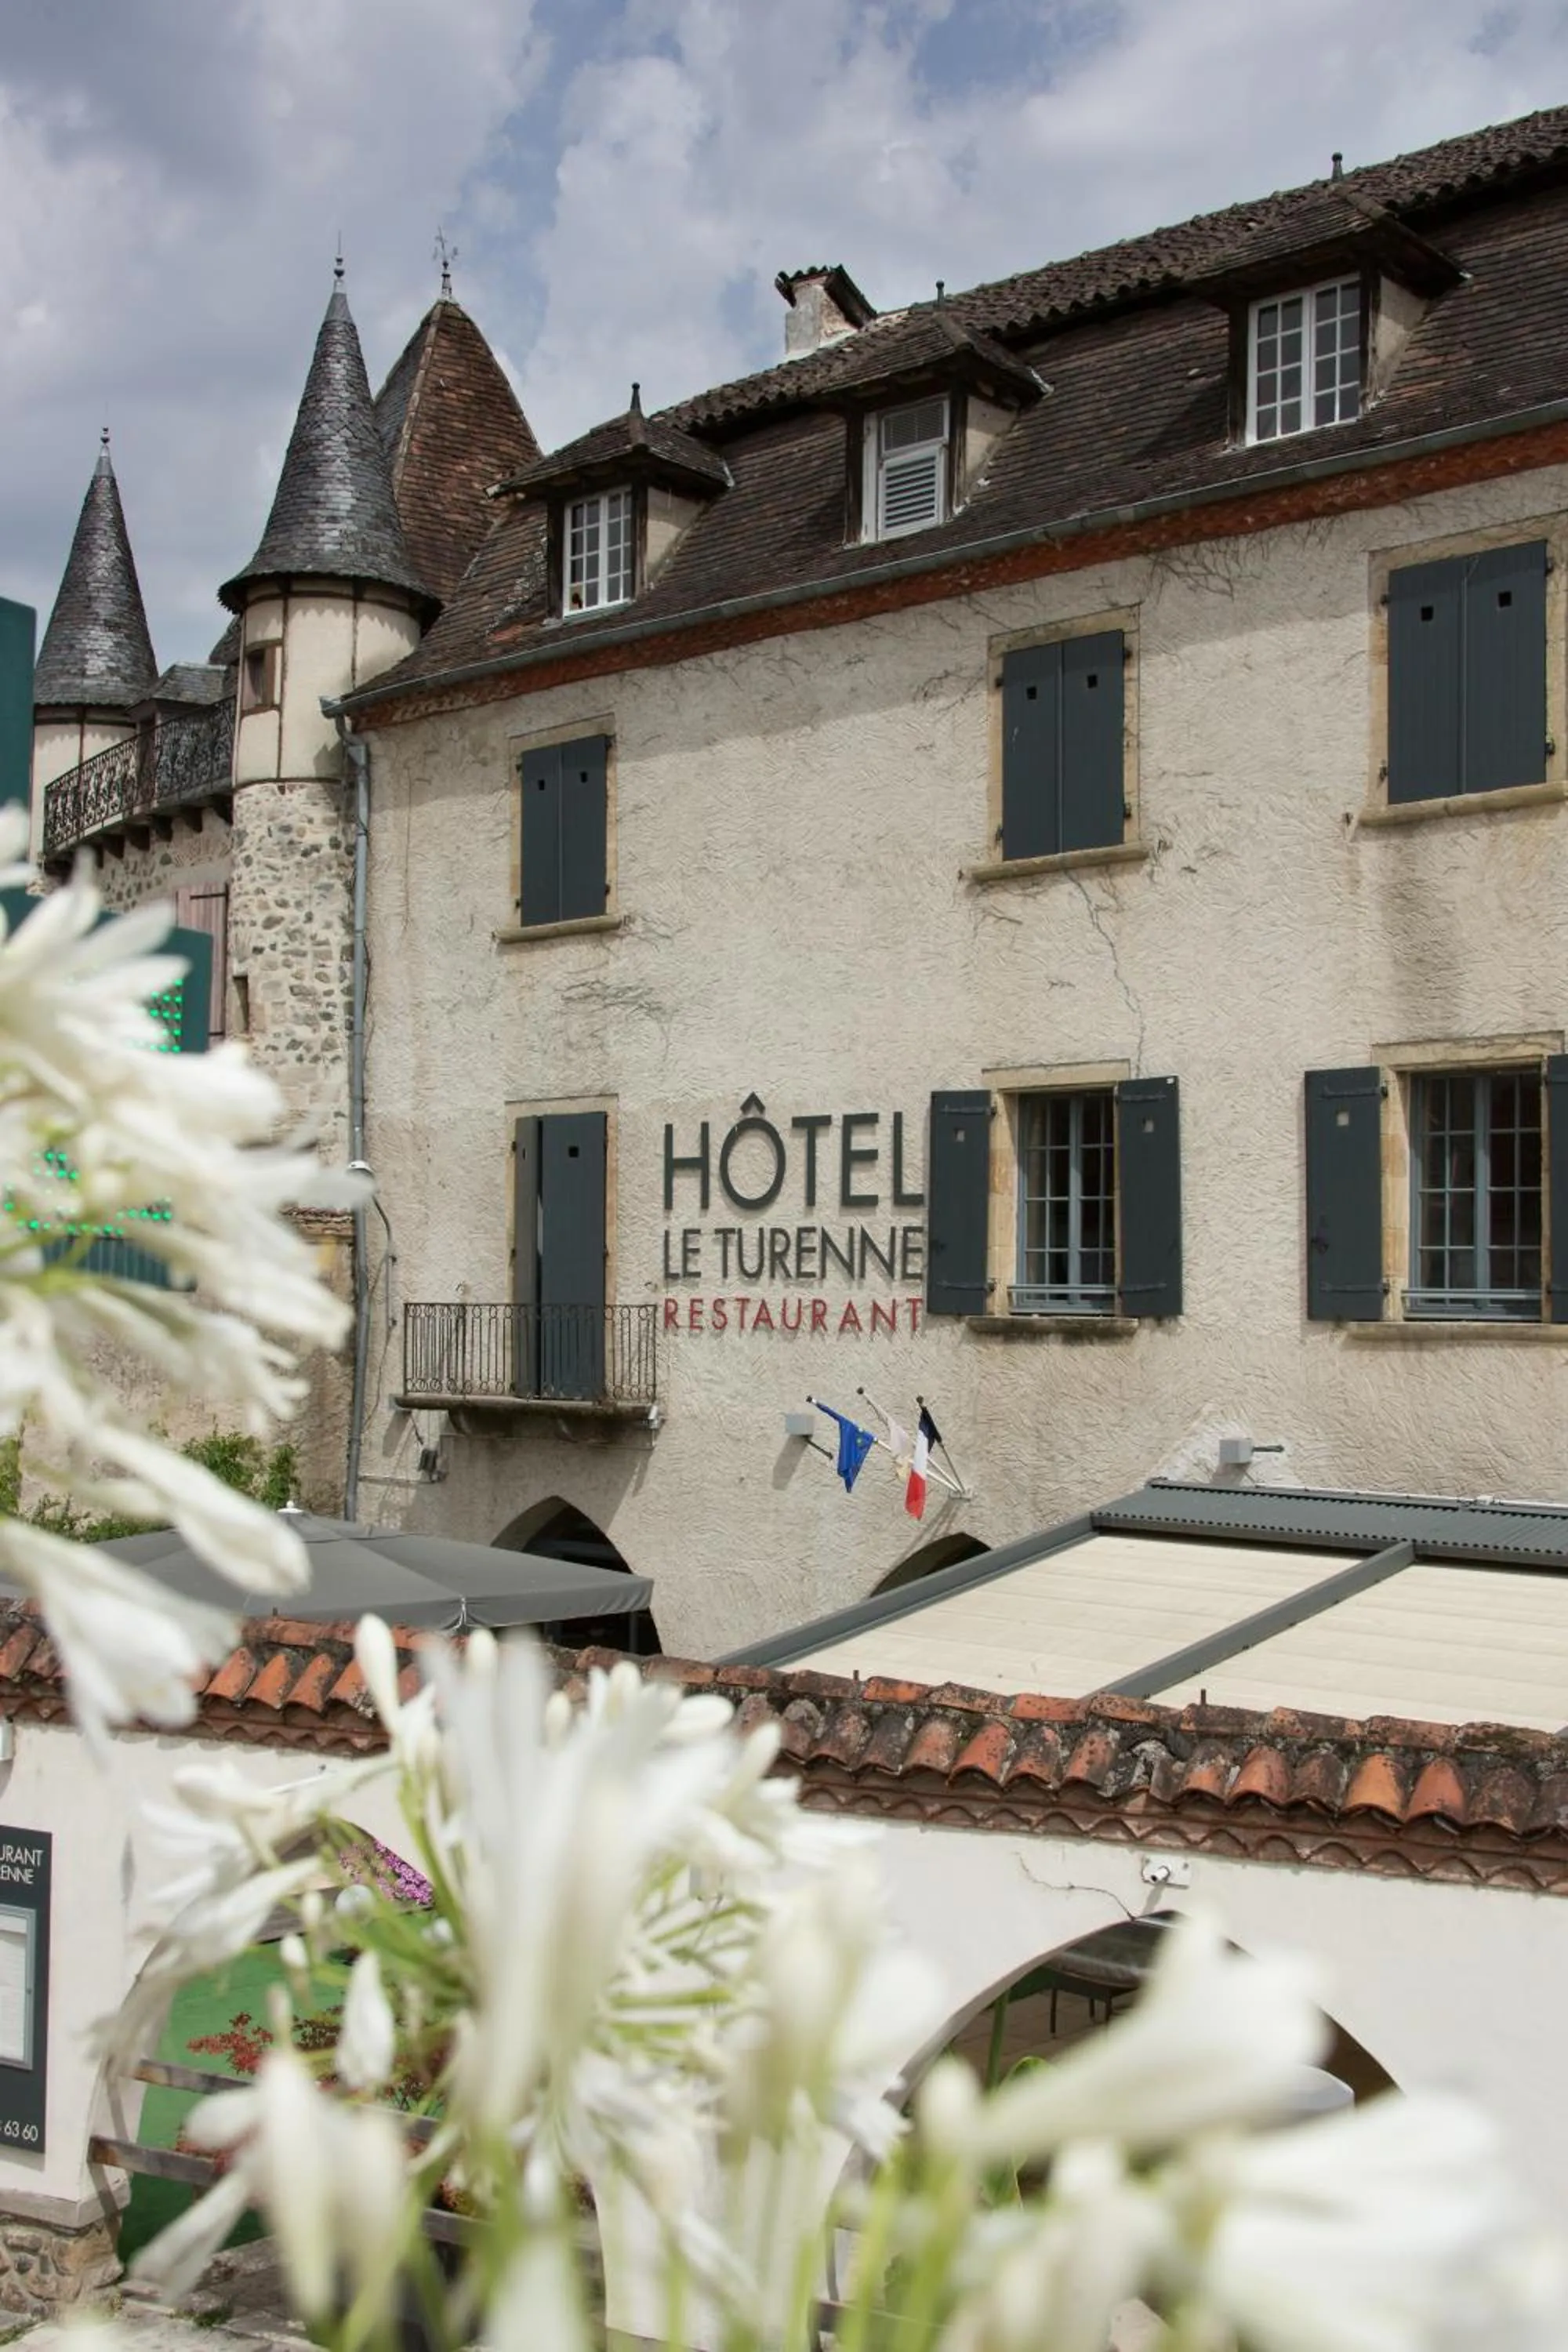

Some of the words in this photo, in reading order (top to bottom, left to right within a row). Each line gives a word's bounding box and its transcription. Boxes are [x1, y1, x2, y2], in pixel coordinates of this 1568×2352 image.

[664, 1091, 924, 1210] HÔTEL
[664, 1229, 702, 1279] LE
[715, 1226, 924, 1279] TURENNE
[664, 1298, 924, 1331] RESTAURANT
[0, 1864, 34, 1884] ENNE
[5, 2120, 20, 2137] 63
[22, 2124, 38, 2141] 60
